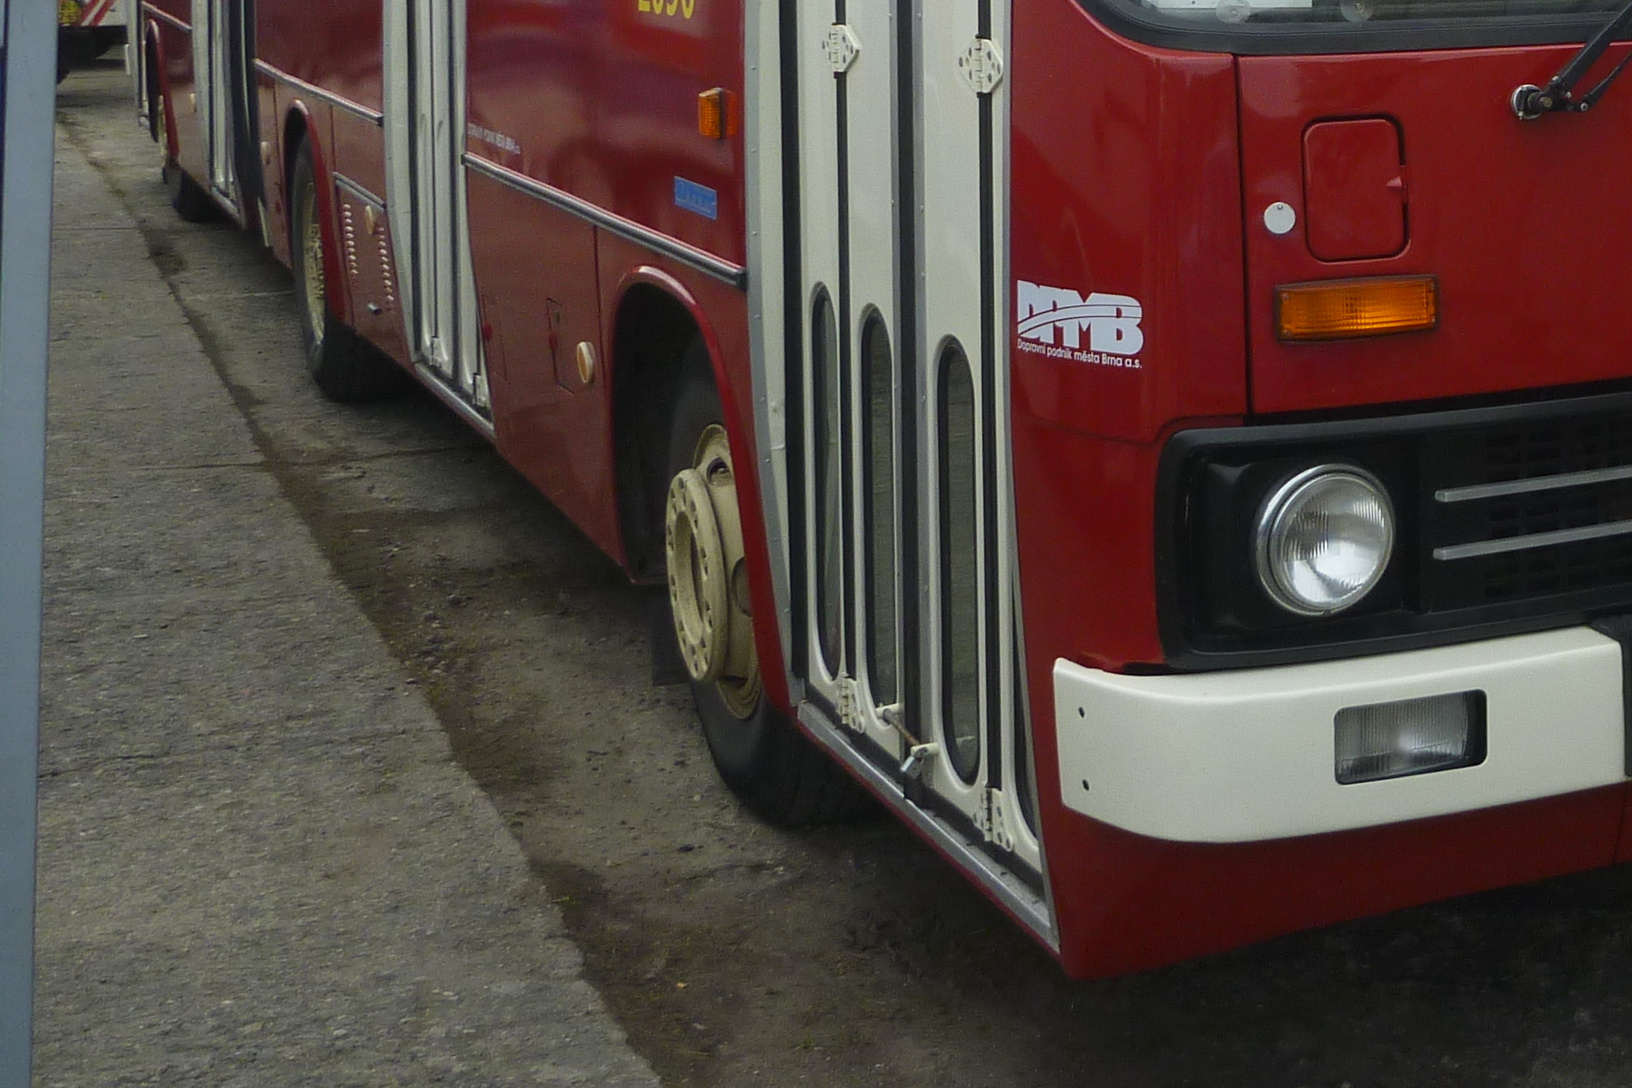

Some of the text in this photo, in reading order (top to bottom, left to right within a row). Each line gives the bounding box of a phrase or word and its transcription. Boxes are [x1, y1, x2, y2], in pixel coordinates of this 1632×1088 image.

[1046, 347, 1073, 359] podnik
[1073, 351, 1100, 364] města
[1101, 353, 1123, 367] Brna
[1125, 358, 1143, 369] a.s.
